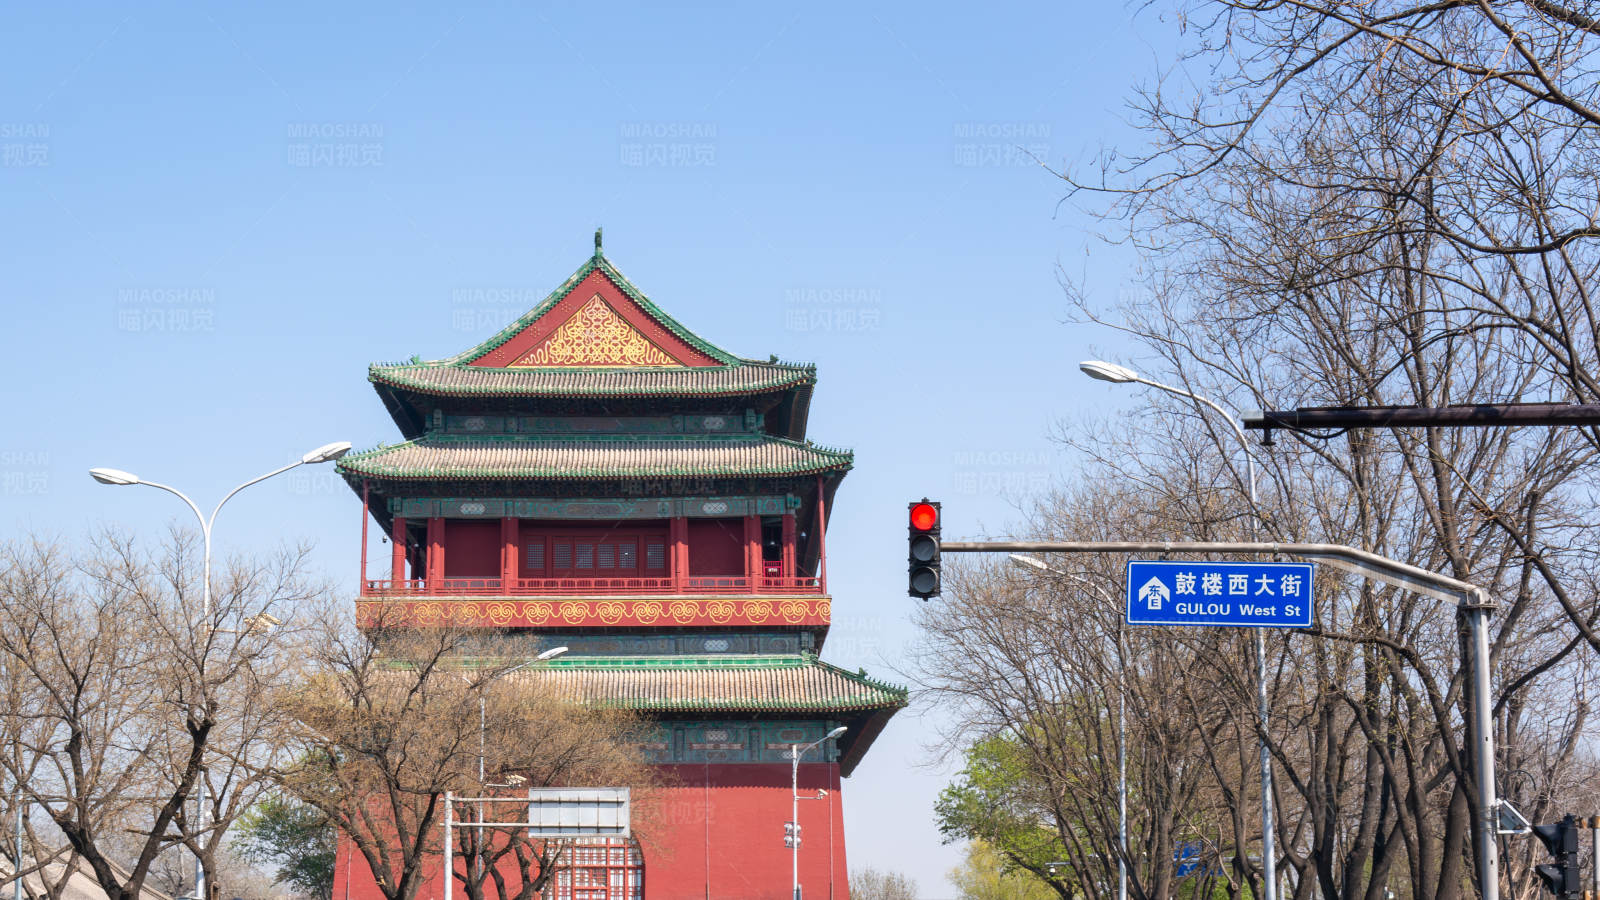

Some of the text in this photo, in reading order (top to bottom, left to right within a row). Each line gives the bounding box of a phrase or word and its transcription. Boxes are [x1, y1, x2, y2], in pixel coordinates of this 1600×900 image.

[1148, 585, 1161, 596] 东
[1175, 572, 1302, 597] 鼓楼西大街
[1151, 599, 1159, 607] E
[1175, 602, 1302, 617] GULOU West St
